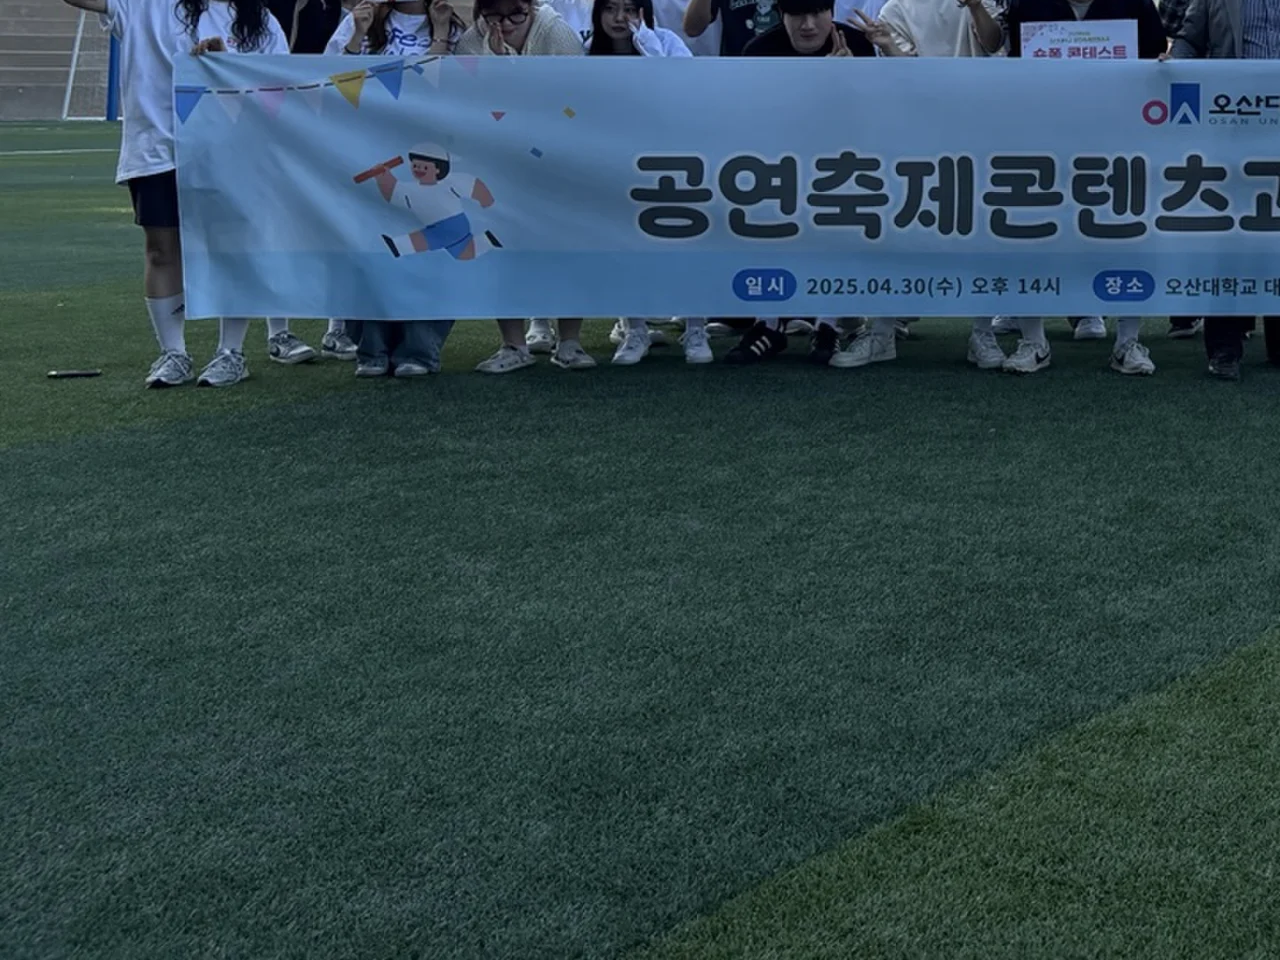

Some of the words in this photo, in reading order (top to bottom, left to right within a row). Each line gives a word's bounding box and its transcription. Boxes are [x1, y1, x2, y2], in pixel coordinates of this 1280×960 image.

[1067, 45, 1127, 59] 콘테스트
[1208, 117, 1249, 126] OSAN
[745, 276, 785, 295] 일시
[806, 276, 962, 297] 2025.04.30(수)
[970, 277, 1009, 296] 오후
[1017, 277, 1062, 296] 14시
[1105, 277, 1144, 295] 장소
[1165, 277, 1257, 296] 오산대학교
